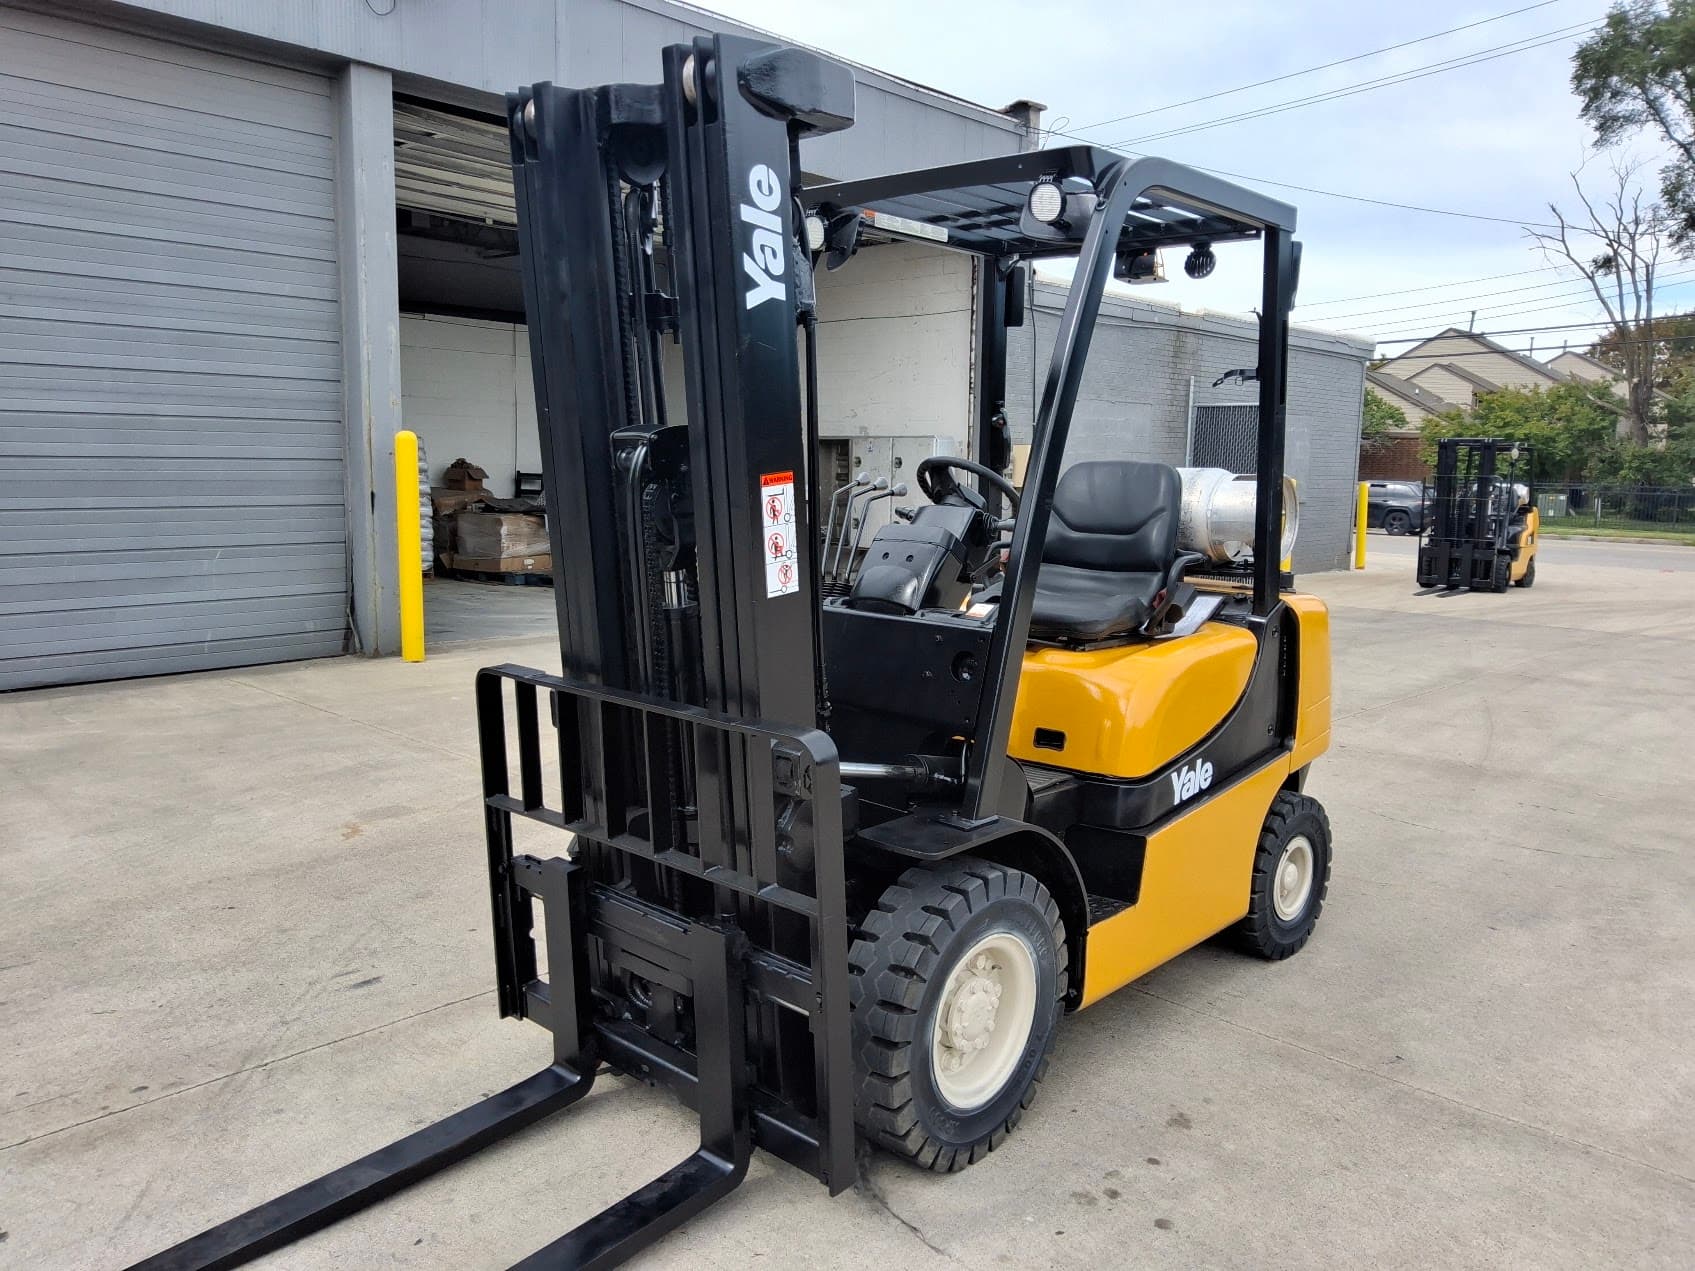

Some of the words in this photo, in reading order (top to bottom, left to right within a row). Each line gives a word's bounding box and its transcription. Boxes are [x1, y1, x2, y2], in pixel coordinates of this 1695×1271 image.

[740, 164, 787, 310] Yale
[769, 473, 793, 483] WARNING
[1171, 758, 1213, 805] Yale
